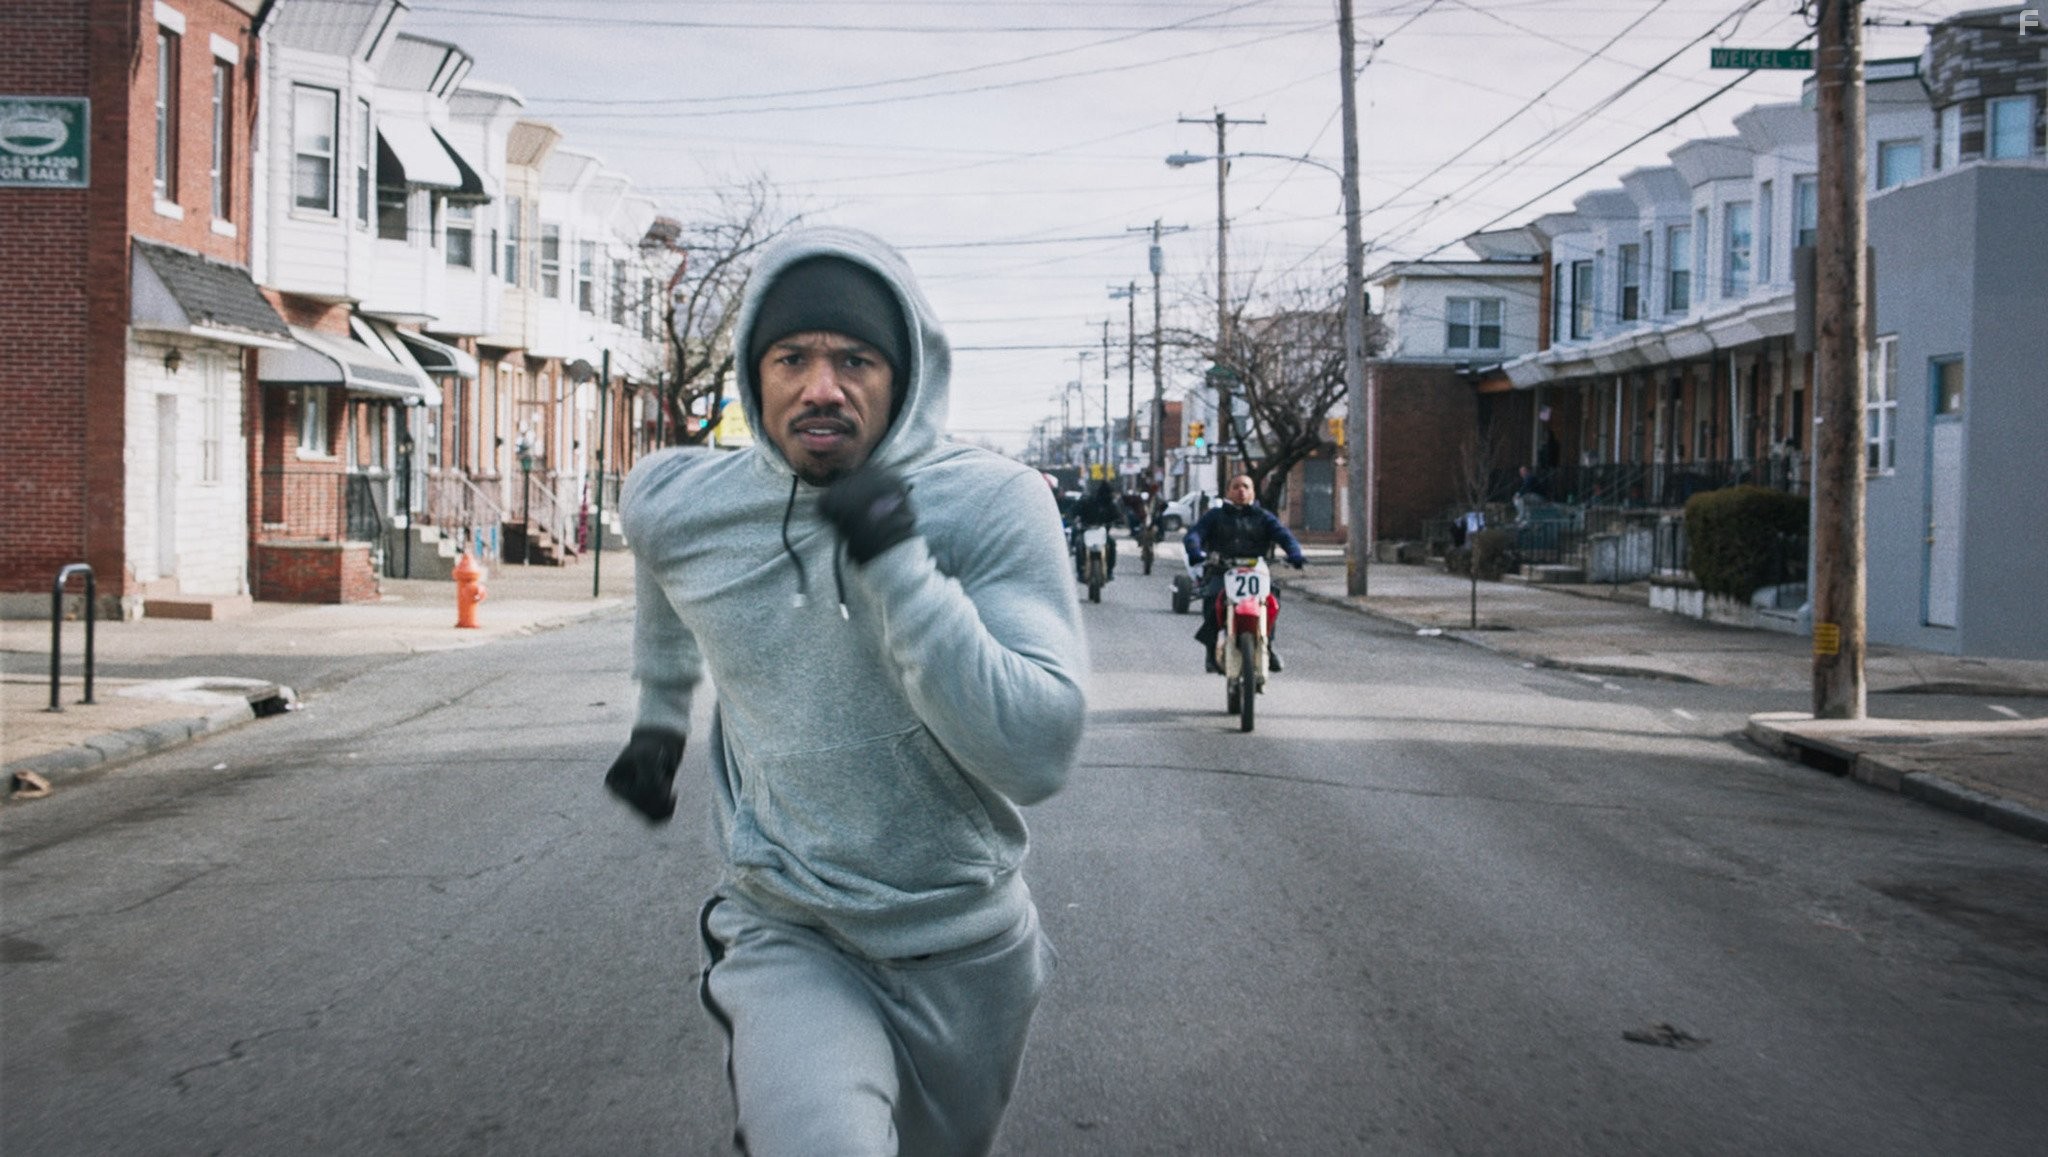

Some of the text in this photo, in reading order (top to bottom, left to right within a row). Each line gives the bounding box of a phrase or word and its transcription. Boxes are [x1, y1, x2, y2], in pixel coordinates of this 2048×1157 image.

[1714, 50, 1808, 68] WEIKEL ST
[0, 168, 68, 180] OR SALE
[1235, 575, 1260, 597] 20
